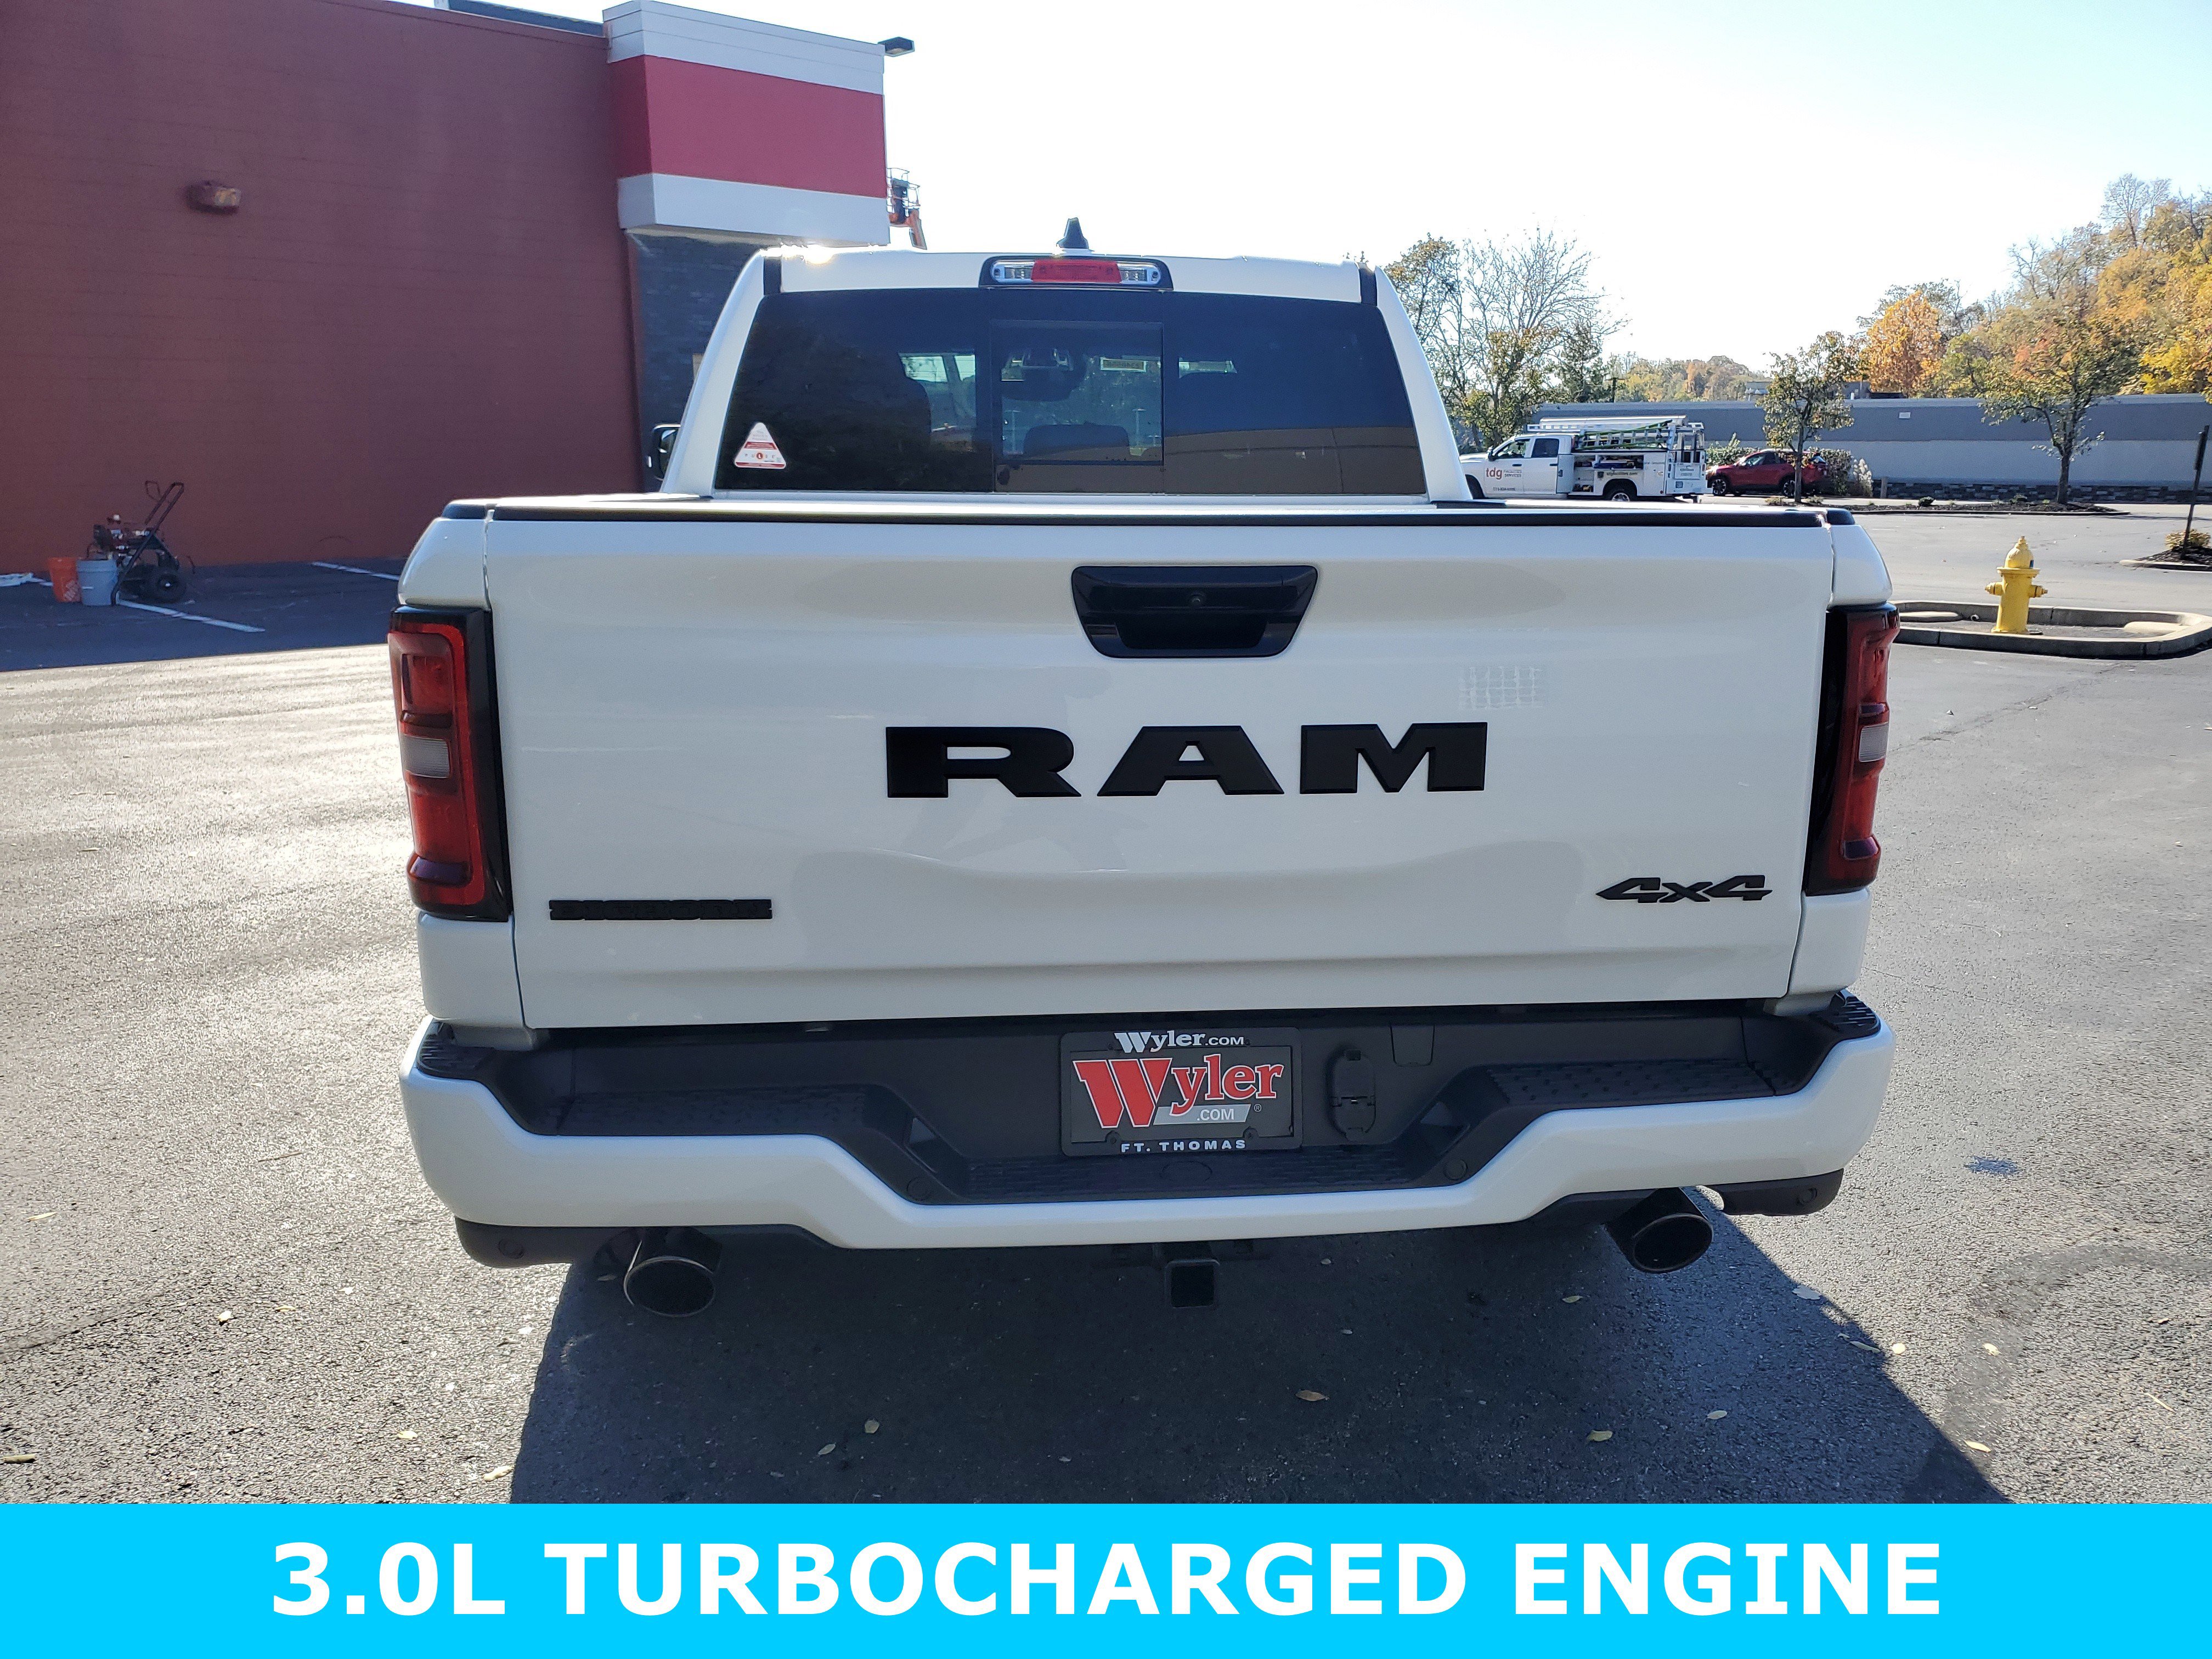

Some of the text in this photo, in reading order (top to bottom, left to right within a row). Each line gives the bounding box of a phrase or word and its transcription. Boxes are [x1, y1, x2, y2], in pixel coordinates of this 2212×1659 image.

[1486, 467, 1503, 480] tdg
[885, 721, 1488, 798] RAM
[1595, 874, 1773, 904] 4x4
[1072, 1053, 1285, 1129] Wyler
[1196, 1108, 1235, 1121] .COM
[1121, 1139, 1246, 1153] FT. THOMAS
